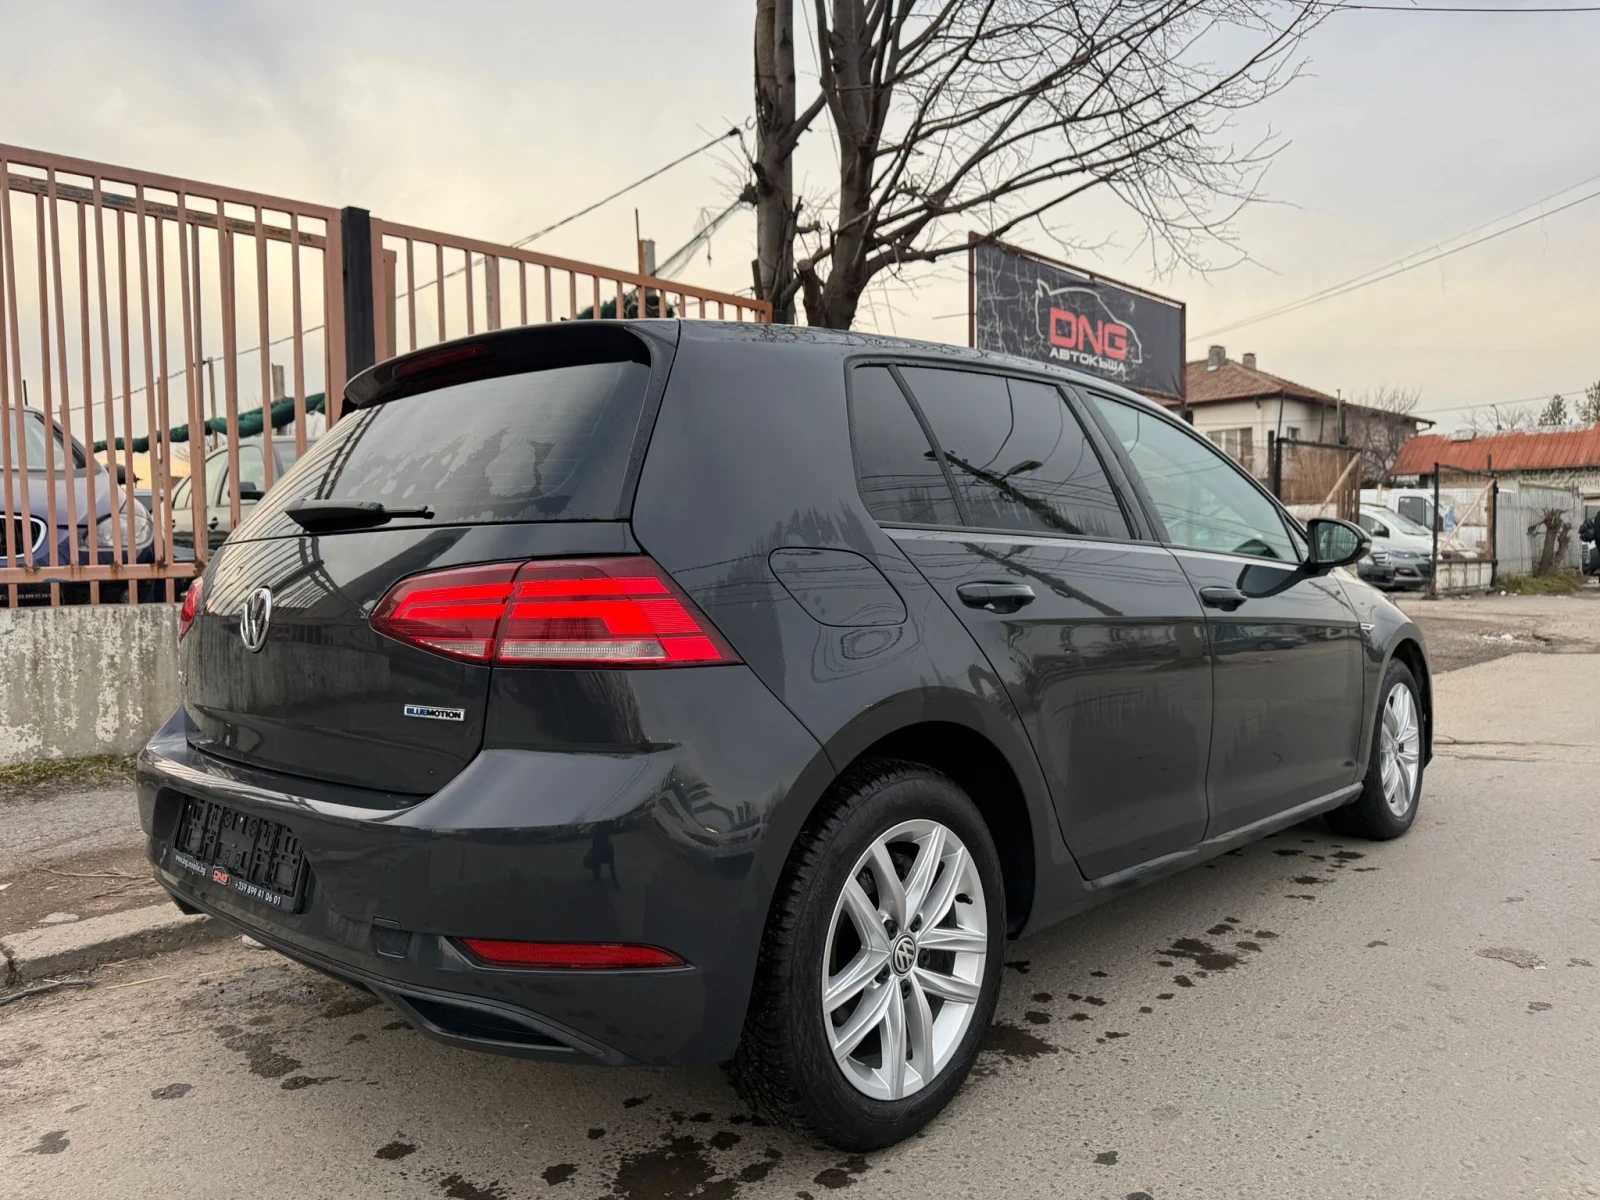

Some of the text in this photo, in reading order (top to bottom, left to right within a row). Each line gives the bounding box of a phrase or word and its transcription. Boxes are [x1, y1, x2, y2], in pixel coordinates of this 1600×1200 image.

[1050, 306, 1127, 360] DNG
[406, 707, 461, 719] BLUEMOTION
[213, 869, 229, 883] DNG
[235, 881, 247, 892] +359
[247, 885, 257, 896] 899
[258, 889, 265, 899] 41
[265, 892, 273, 902] 06
[273, 895, 281, 905] 01
